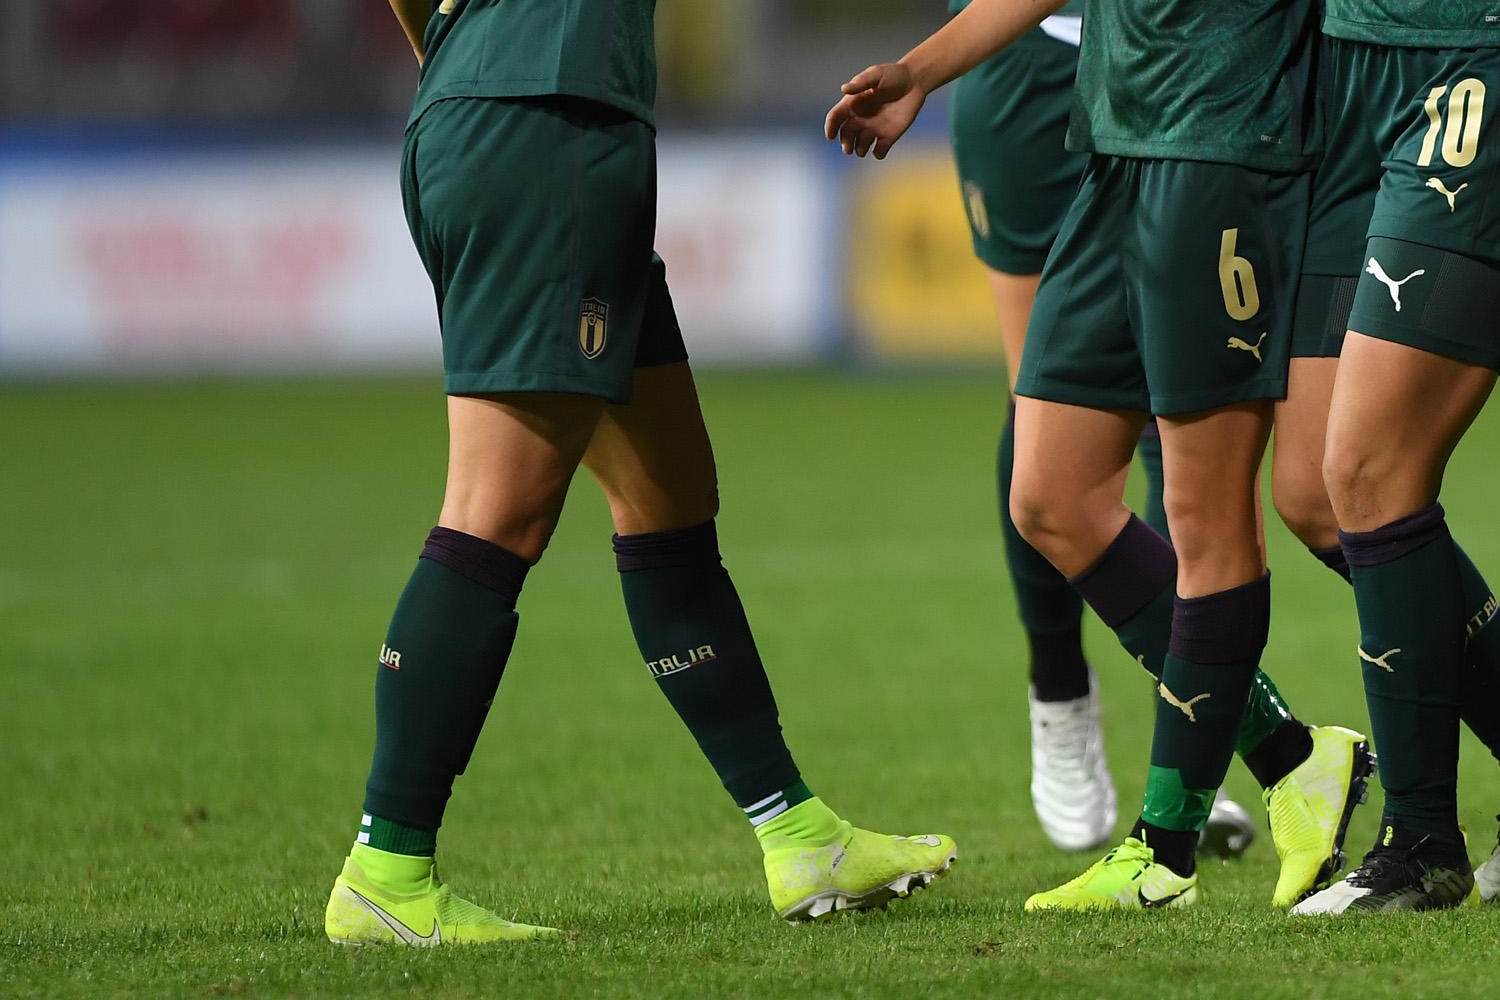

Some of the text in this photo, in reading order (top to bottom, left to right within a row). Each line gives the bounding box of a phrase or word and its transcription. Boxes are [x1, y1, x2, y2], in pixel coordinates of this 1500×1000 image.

[1416, 78, 1486, 168] 10
[1218, 228, 1260, 321] 6
[379, 643, 402, 669] LIA
[647, 645, 717, 675] TALIA
